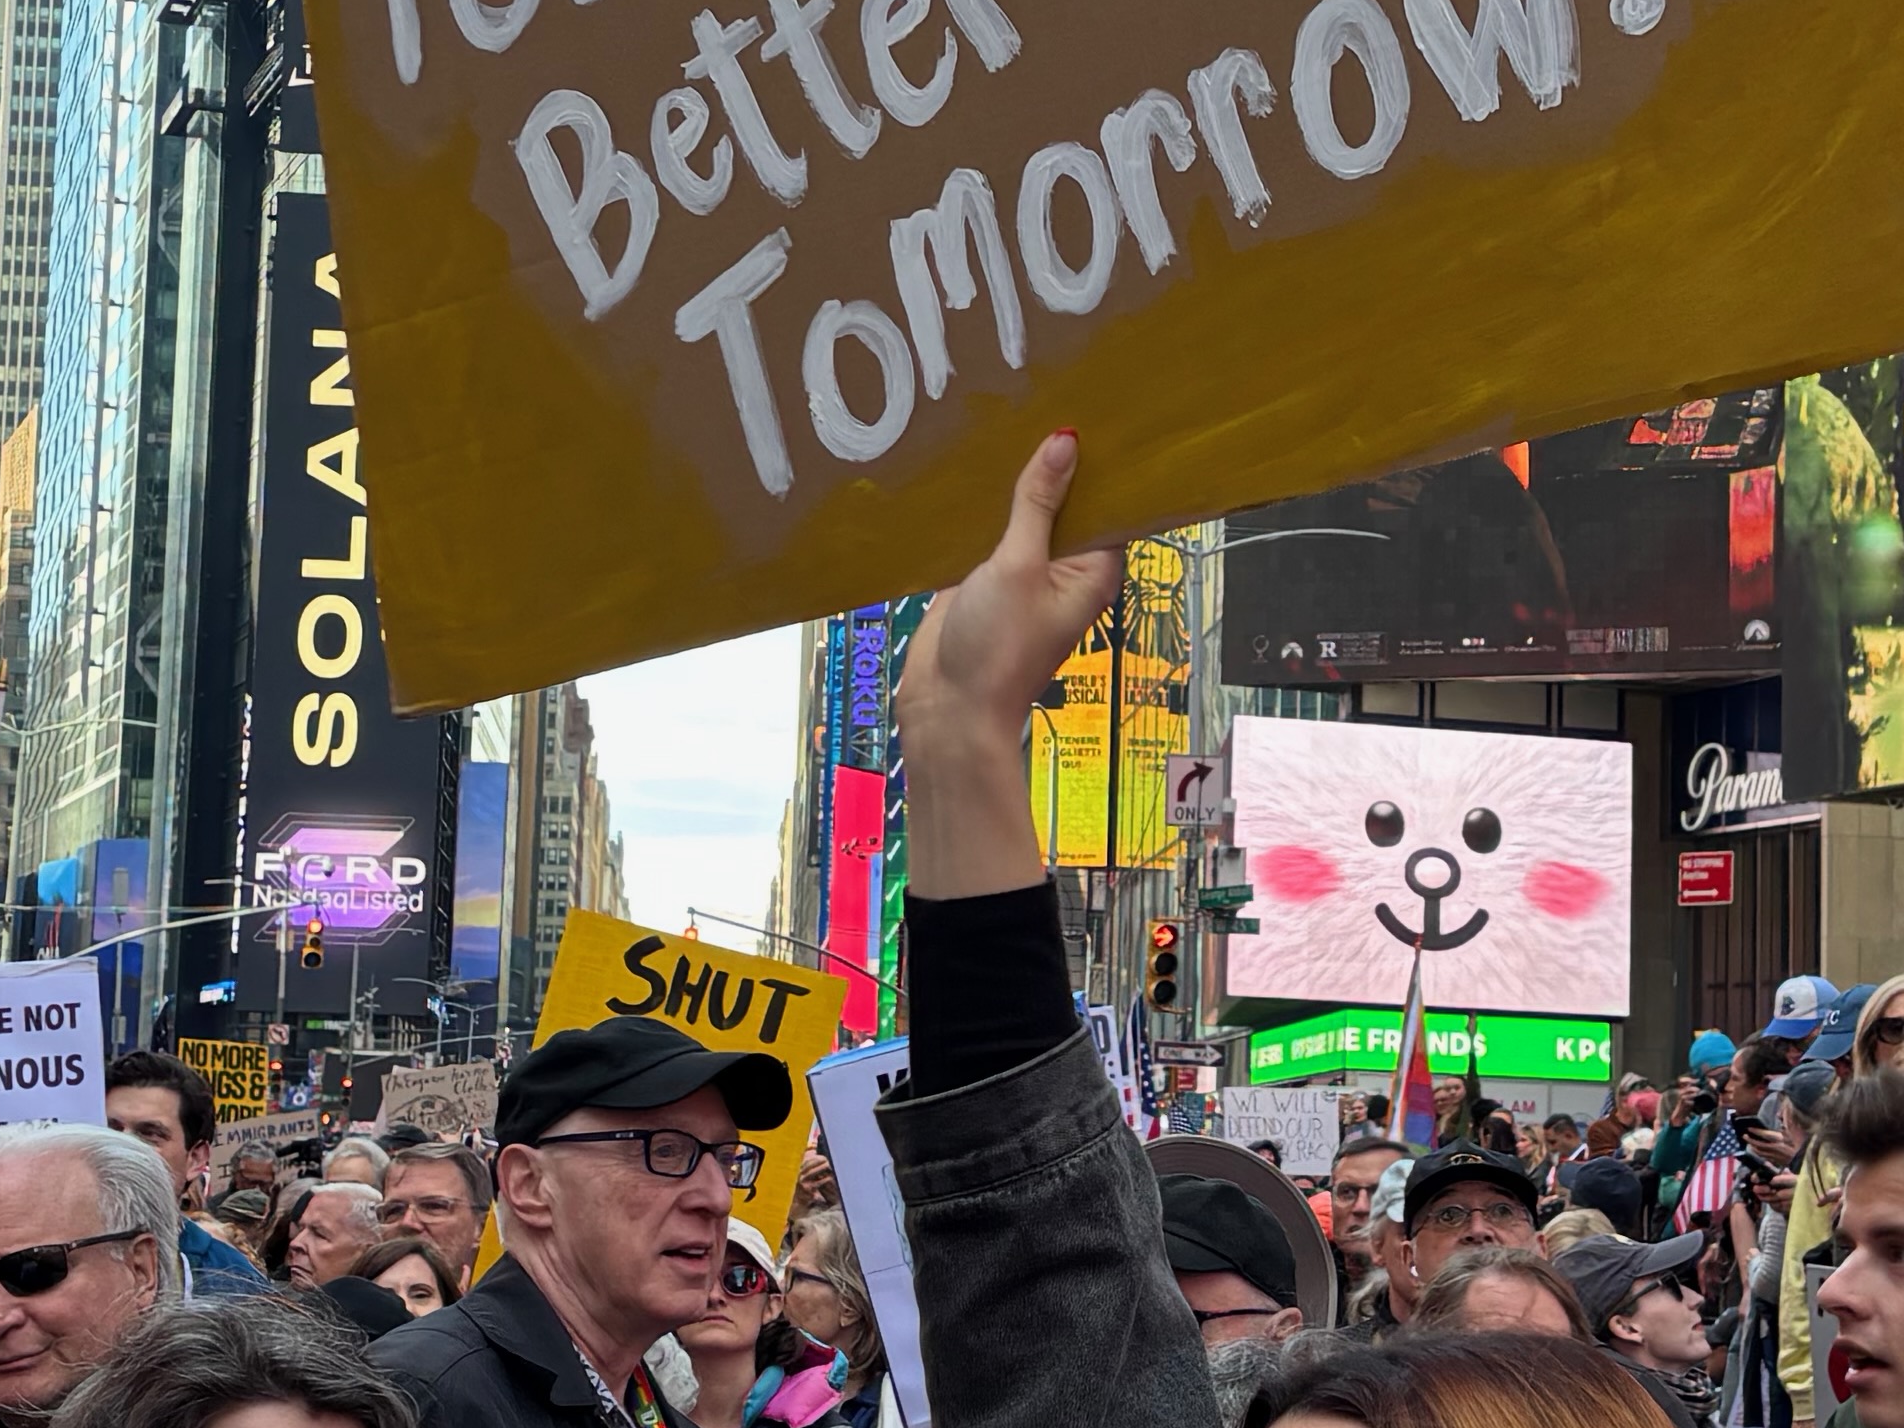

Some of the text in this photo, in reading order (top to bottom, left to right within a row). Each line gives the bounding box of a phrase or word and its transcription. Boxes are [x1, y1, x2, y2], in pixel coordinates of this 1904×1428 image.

[853, 628, 887, 726] ROKU
[1065, 688, 1107, 705] USICAL
[1175, 807, 1215, 821] ONLY
[607, 935, 811, 1044] SHUT
[24, 1002, 81, 1033] NOT
[181, 1041, 266, 1071] NO MORE
[201, 1071, 265, 1101] NGS &
[214, 1118, 315, 1147] IMMIGRANTS
